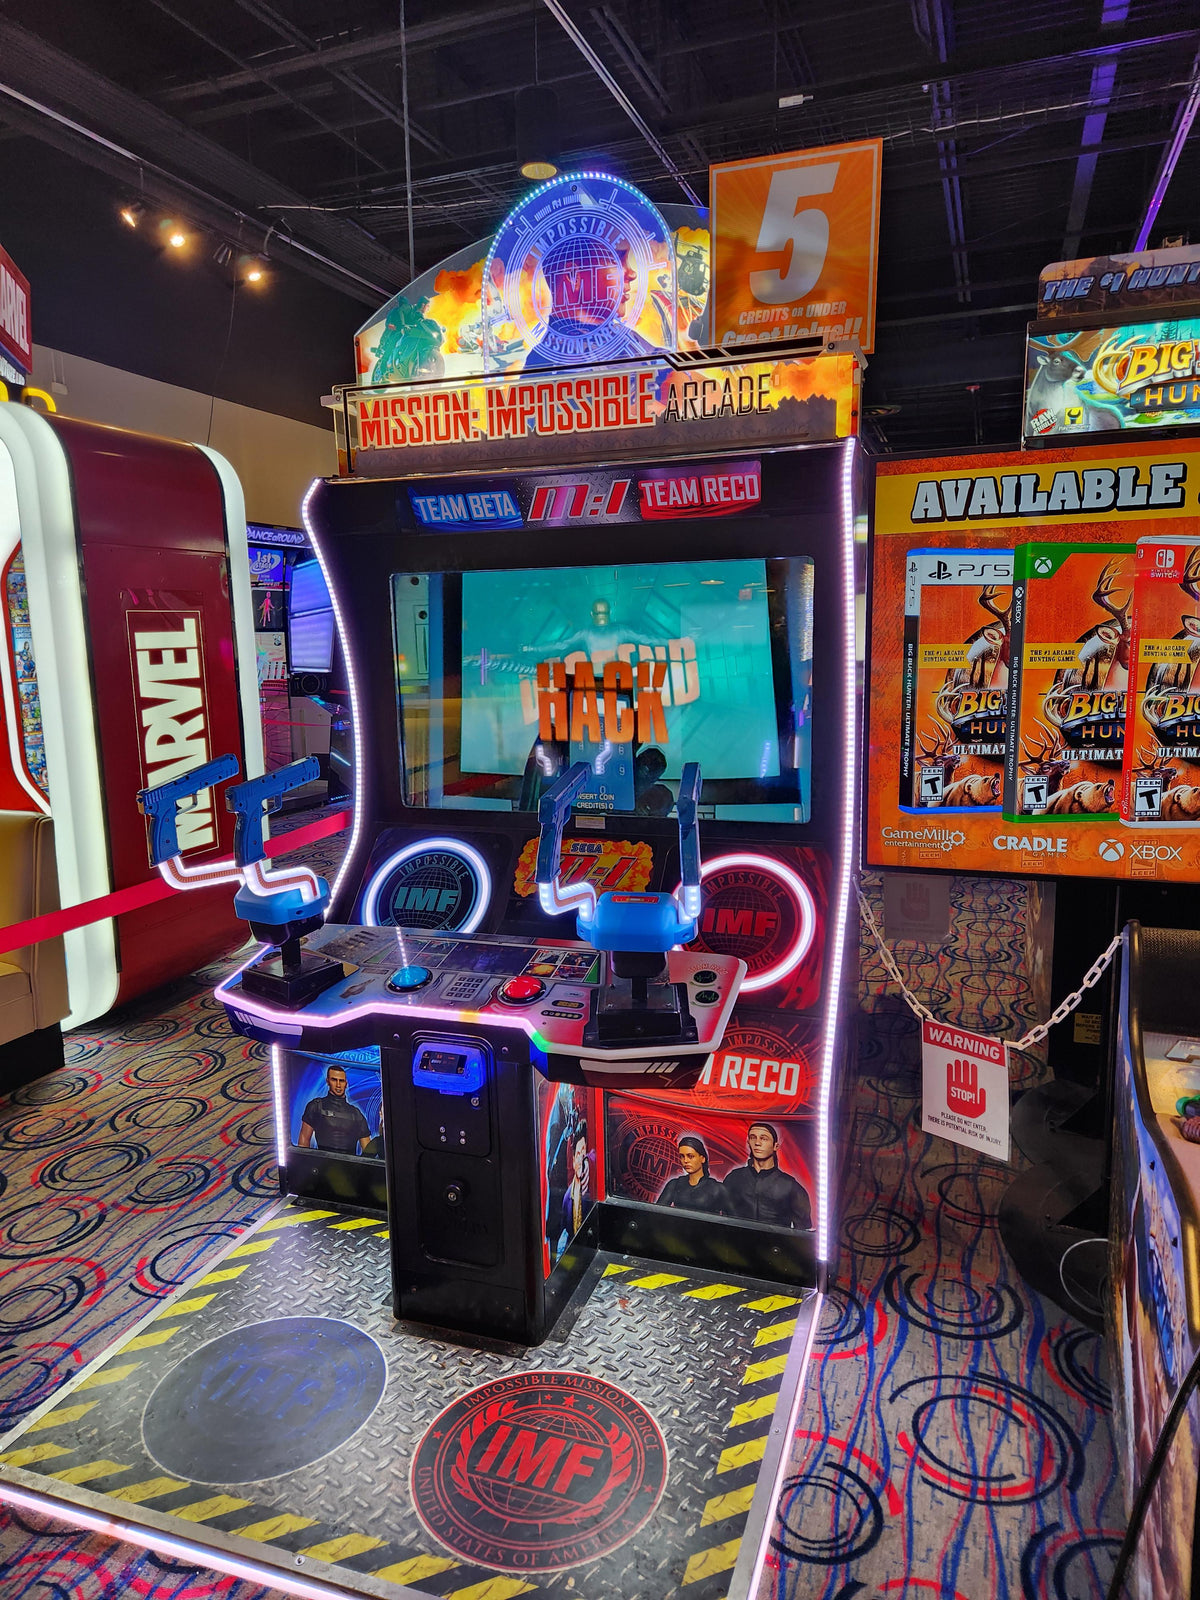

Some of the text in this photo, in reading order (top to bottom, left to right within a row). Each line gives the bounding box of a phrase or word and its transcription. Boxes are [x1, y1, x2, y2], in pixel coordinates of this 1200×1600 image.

[530, 216, 625, 260] IMPOSSIBLE
[750, 161, 840, 304] 5
[538, 266, 619, 309] IMF
[1043, 276, 1094, 302] THE
[1100, 272, 1125, 294] #1
[738, 301, 847, 326] CREDITS OR UNDER
[1118, 340, 1194, 394] BIG
[359, 372, 771, 448] MISSION: IMPOSSIBLE ARCADE
[1031, 408, 1054, 429] RAW
[641, 475, 760, 507] TEAM RECO
[911, 463, 1186, 522] AVAILABLE
[416, 492, 517, 521] TEAM BETA
[958, 563, 1010, 577] PS5
[536, 661, 669, 743] HACK
[955, 690, 1001, 719] BIG
[1063, 692, 1117, 723] BIG
[924, 776, 941, 795] T
[1027, 785, 1045, 803] T
[1139, 789, 1158, 809] T
[882, 827, 949, 840] GameMill
[884, 840, 941, 849] entertainment
[993, 835, 1068, 853] CRADLE
[570, 842, 604, 854] SEGA
[1129, 845, 1182, 860] XBOX
[399, 855, 469, 880] IMPOSSIBLE
[394, 887, 459, 912] IMF
[702, 872, 786, 900] IMPOSSIBLE
[702, 908, 778, 936] IMF
[748, 948, 778, 971] ORCE
[929, 1026, 1000, 1060] WARNING
[720, 1055, 800, 1096] RECO
[951, 1086, 976, 1104] STOP!
[927, 1115, 940, 1125] THERE
[946, 1121, 967, 1134] POTENTIAL
[968, 1129, 978, 1137] RISK
[941, 1112, 957, 1122] PLEASE
[964, 1119, 972, 1127] NOT
[463, 1375, 659, 1451] IMPOSSIBLE MISSION FORCE
[476, 1425, 603, 1494] IMF
[418, 1466, 635, 1566] UNITED STATES OF AMERICA
